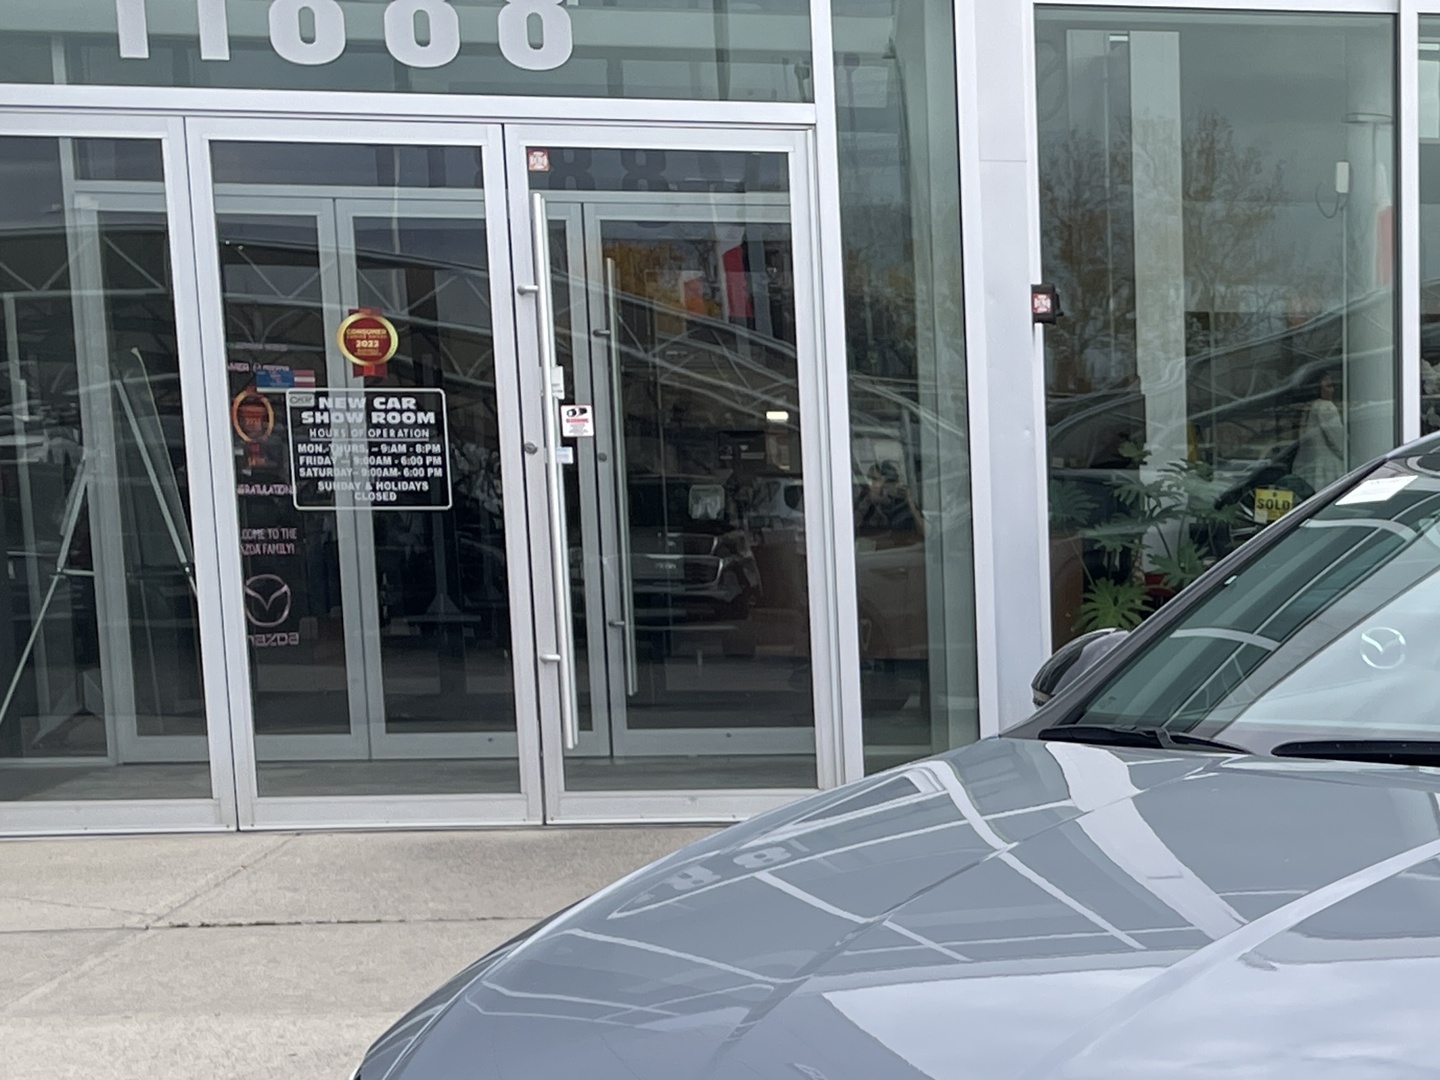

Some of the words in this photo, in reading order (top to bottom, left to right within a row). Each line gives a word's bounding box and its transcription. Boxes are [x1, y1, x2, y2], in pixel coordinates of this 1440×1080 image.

[318, 397, 366, 409] NEW
[373, 397, 417, 410] CAR
[301, 411, 364, 424] SHOW
[371, 411, 436, 424] ROOM
[309, 428, 347, 438] HOURS
[350, 428, 364, 438] OF
[367, 428, 430, 438] OPERATION
[299, 456, 337, 466] FRIDAY
[400, 456, 424, 465] 6:00
[425, 456, 442, 466] PM
[403, 467, 425, 477] 6:00
[427, 467, 443, 477] PM
[317, 481, 361, 491] SUNDAY
[375, 481, 429, 491] HOLIDAYS
[354, 492, 397, 501] CLOSED
[1257, 498, 1291, 510] SOLD
[268, 528, 280, 539] TO
[281, 528, 297, 539] THE
